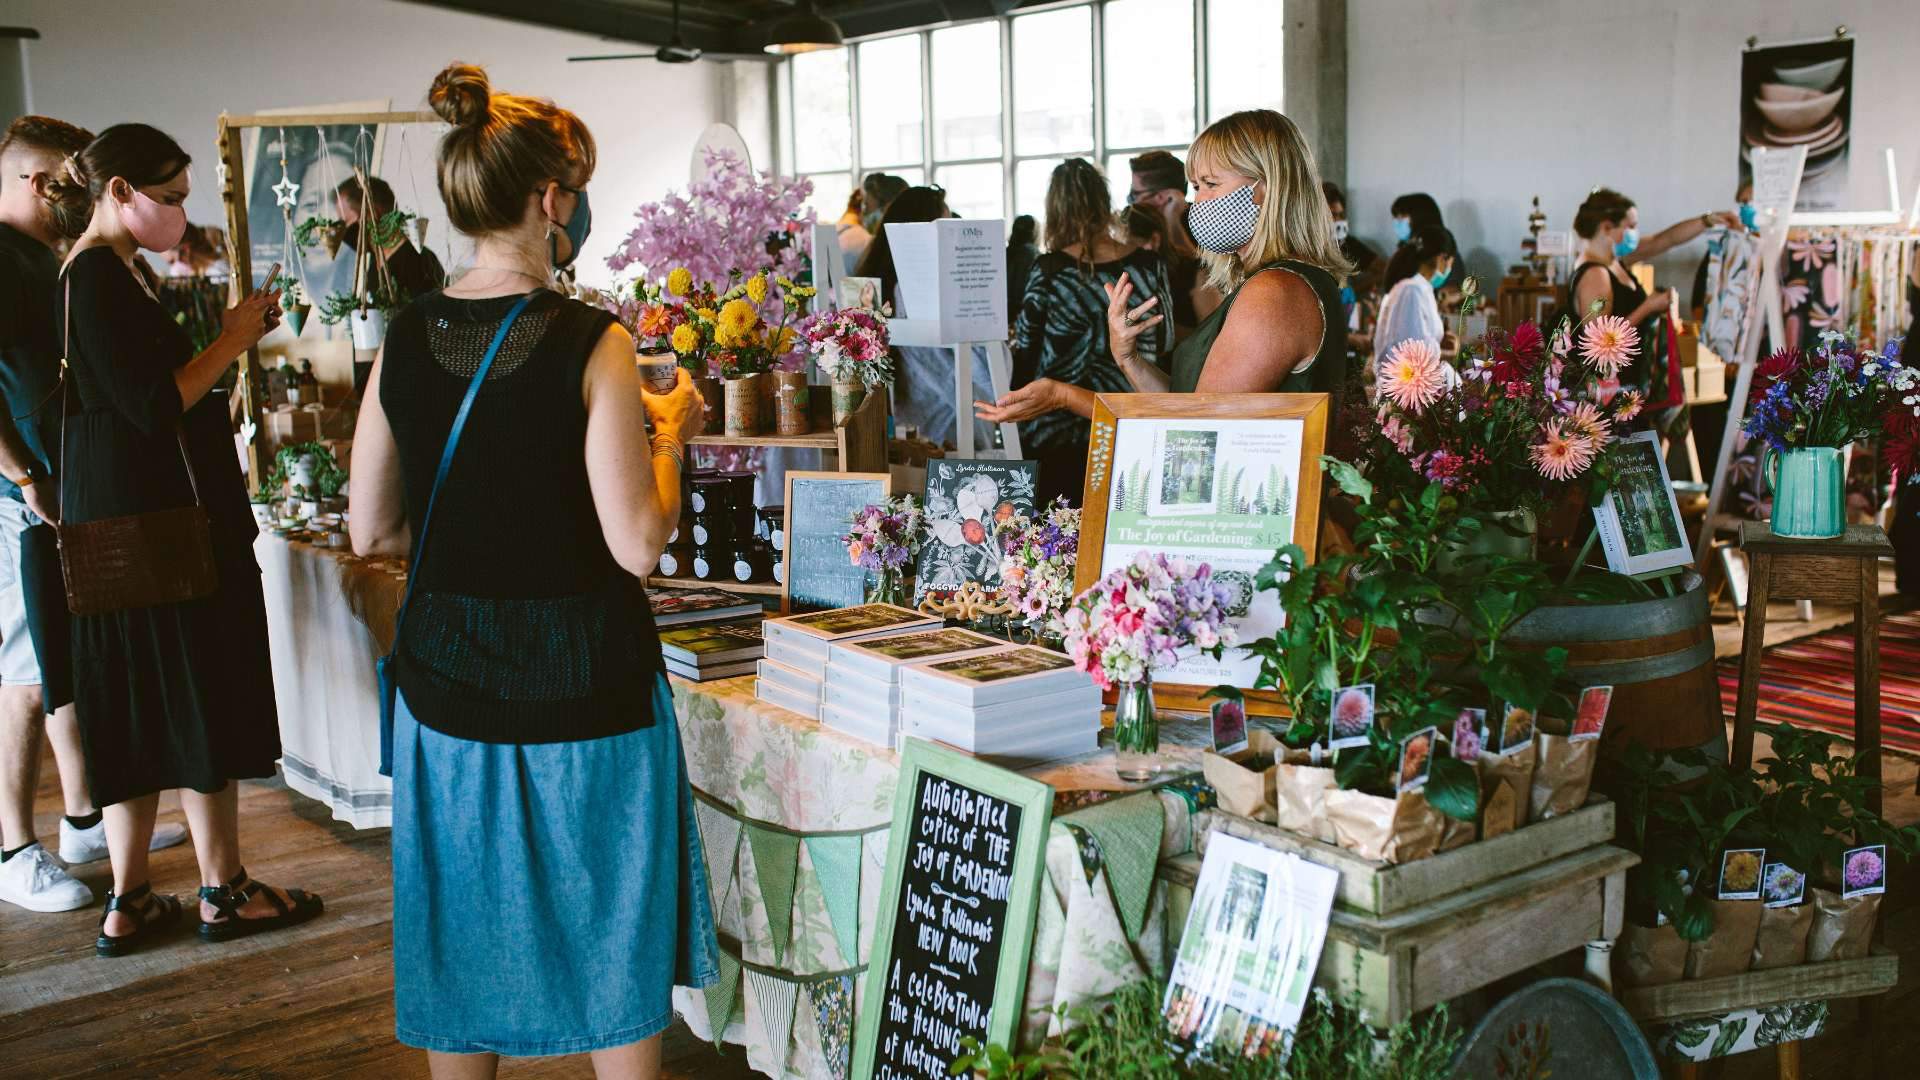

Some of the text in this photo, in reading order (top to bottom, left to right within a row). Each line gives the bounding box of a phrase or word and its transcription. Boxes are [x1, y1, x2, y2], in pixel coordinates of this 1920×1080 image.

[1118, 527, 1142, 541] The
[1144, 528, 1165, 545] Joy
[1167, 529, 1183, 542] of
[1183, 529, 1253, 548] Gardening
[962, 826, 978, 853] of
[912, 842, 934, 873] Joy
[905, 883, 993, 943] Lynda Hallinan's
[917, 922, 980, 976] NEW BOOK
[890, 958, 901, 990] A
